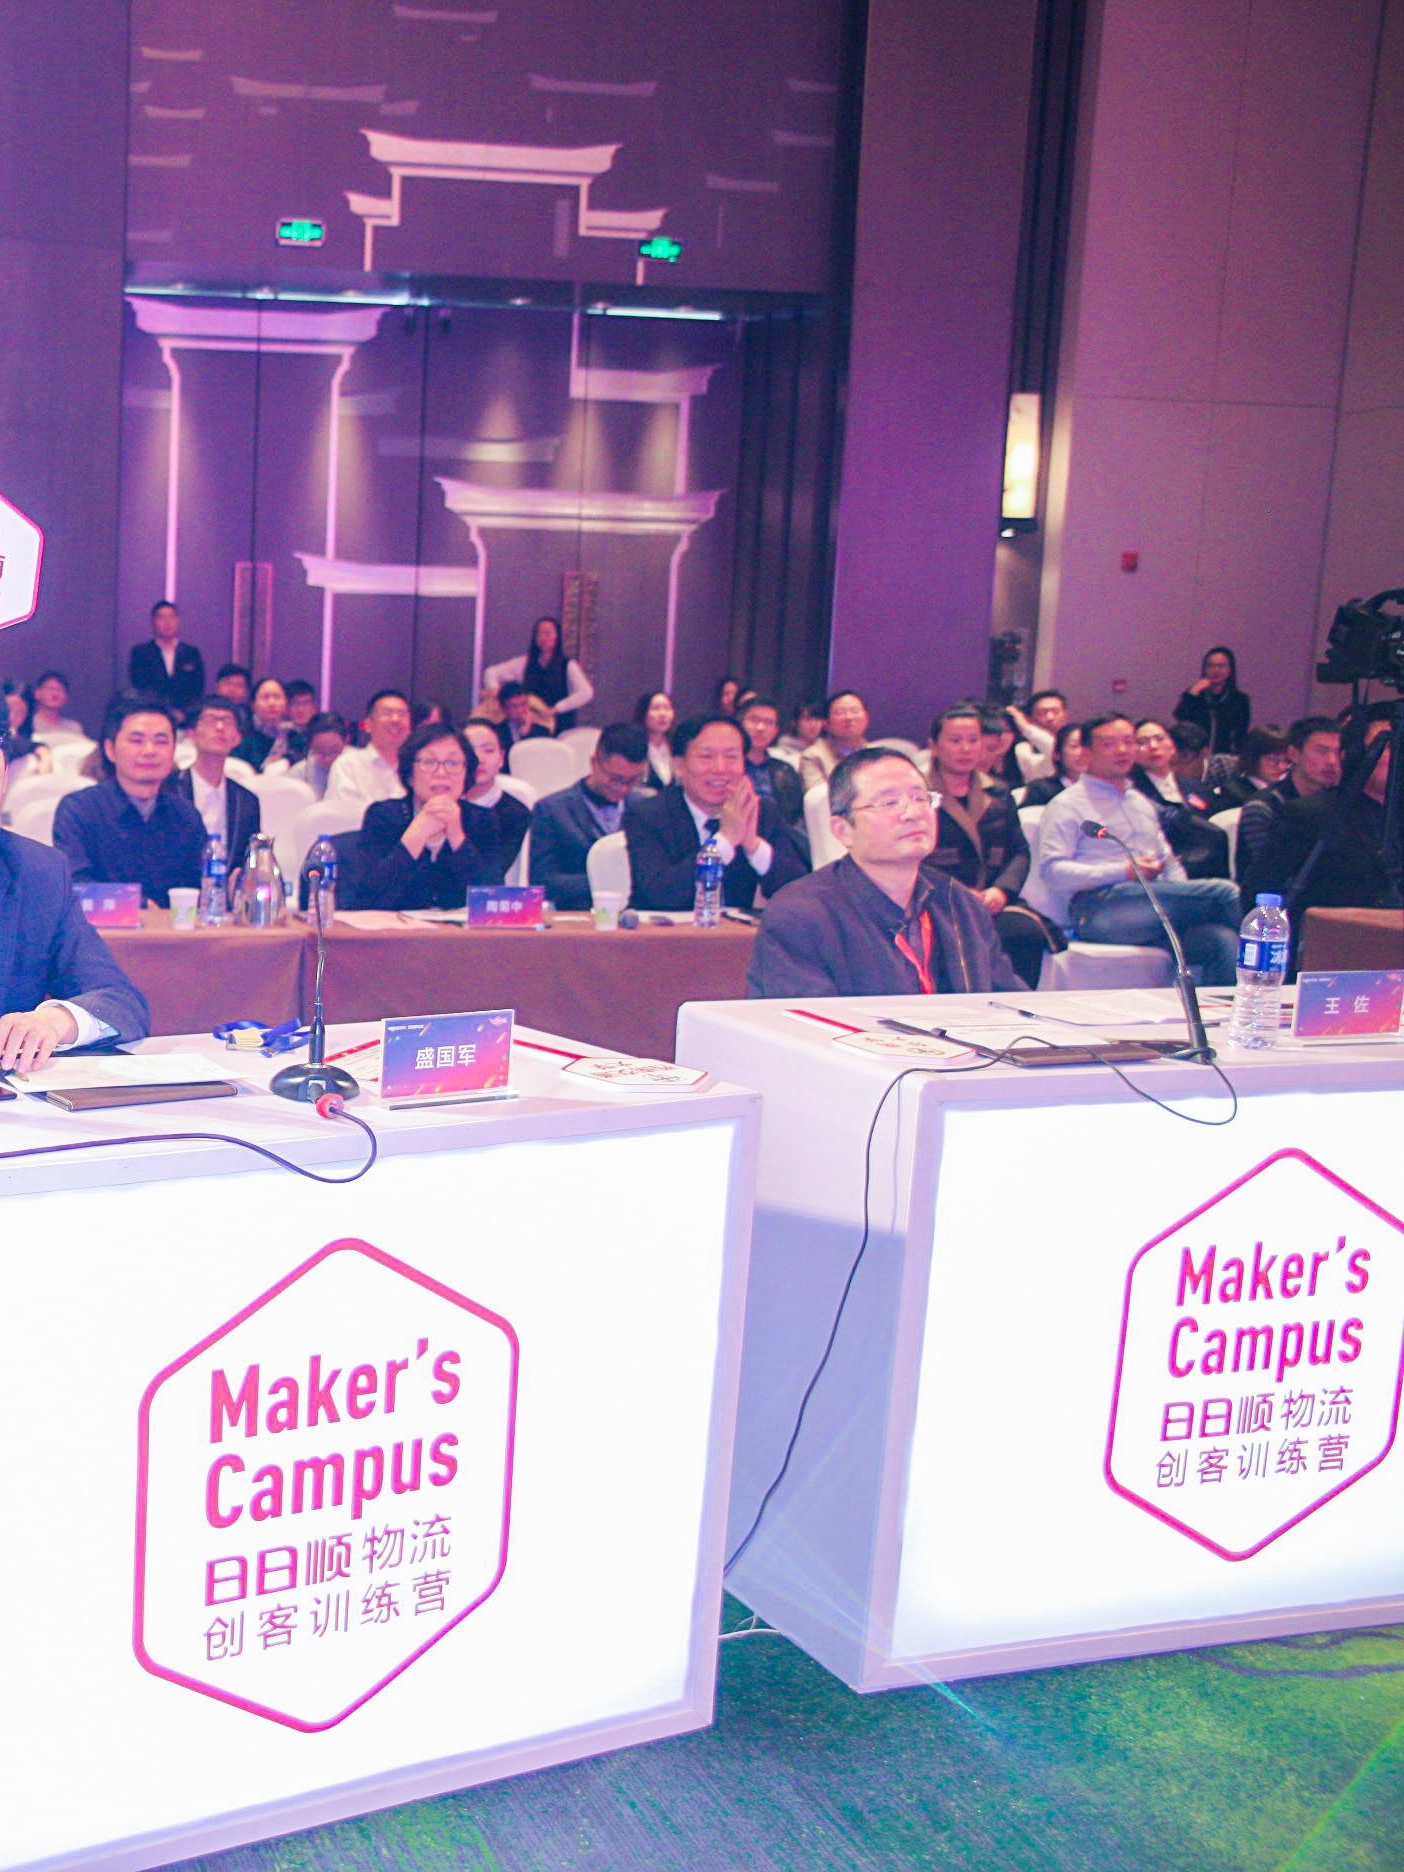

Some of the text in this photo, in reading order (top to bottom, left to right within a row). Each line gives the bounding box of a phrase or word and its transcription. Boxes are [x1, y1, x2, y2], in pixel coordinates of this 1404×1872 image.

[415, 1044, 476, 1069] 盛国军
[1176, 1236, 1371, 1307] Maker's
[1168, 1316, 1364, 1383] Campus
[209, 1337, 461, 1444] Maker's
[1159, 1385, 1354, 1442] 日日顺物流
[205, 1432, 459, 1529] Campus
[1155, 1433, 1351, 1488] 创客训练营
[204, 1513, 452, 1607] 日日顺物流
[203, 1568, 452, 1661] 创客训练营
